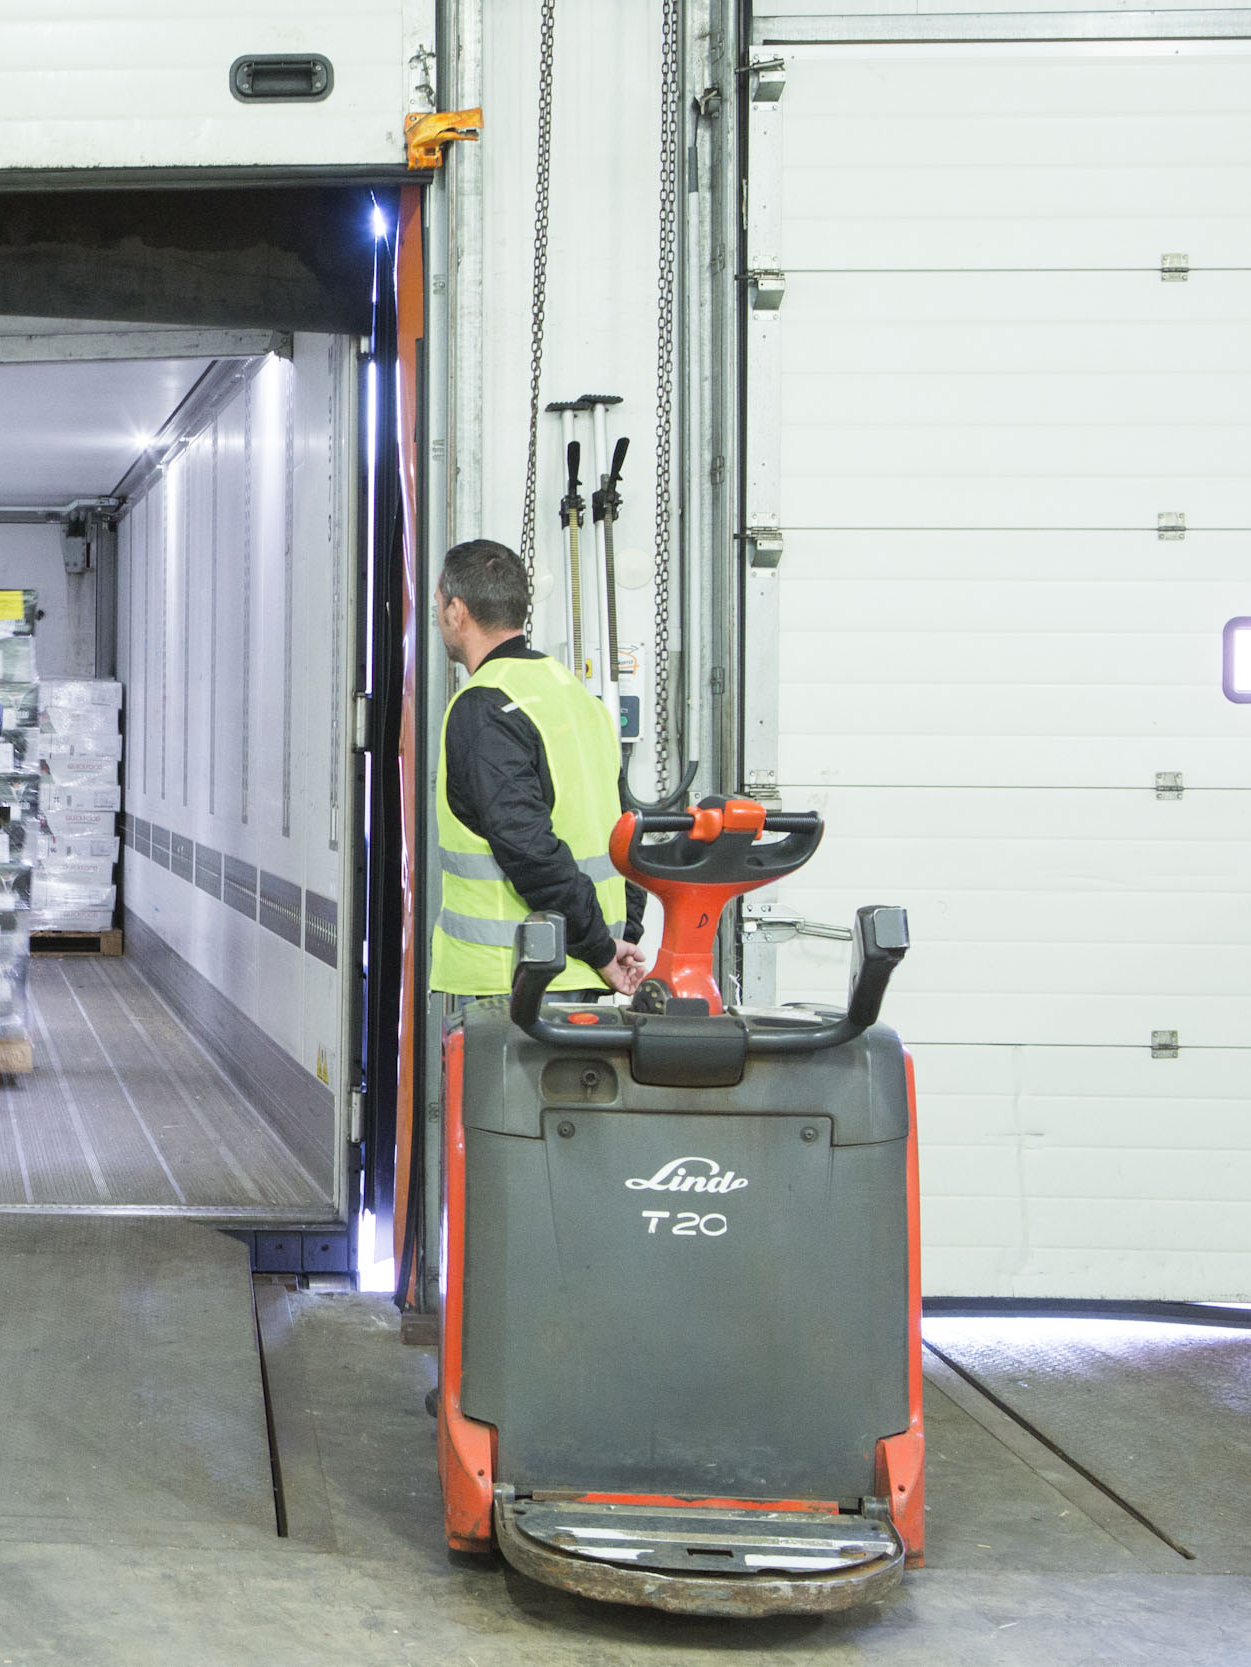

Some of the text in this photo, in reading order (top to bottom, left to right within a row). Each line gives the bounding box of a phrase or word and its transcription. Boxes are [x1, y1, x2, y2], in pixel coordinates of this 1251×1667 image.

[625, 1156, 749, 1193] Linde
[642, 1210, 727, 1236] T 20
